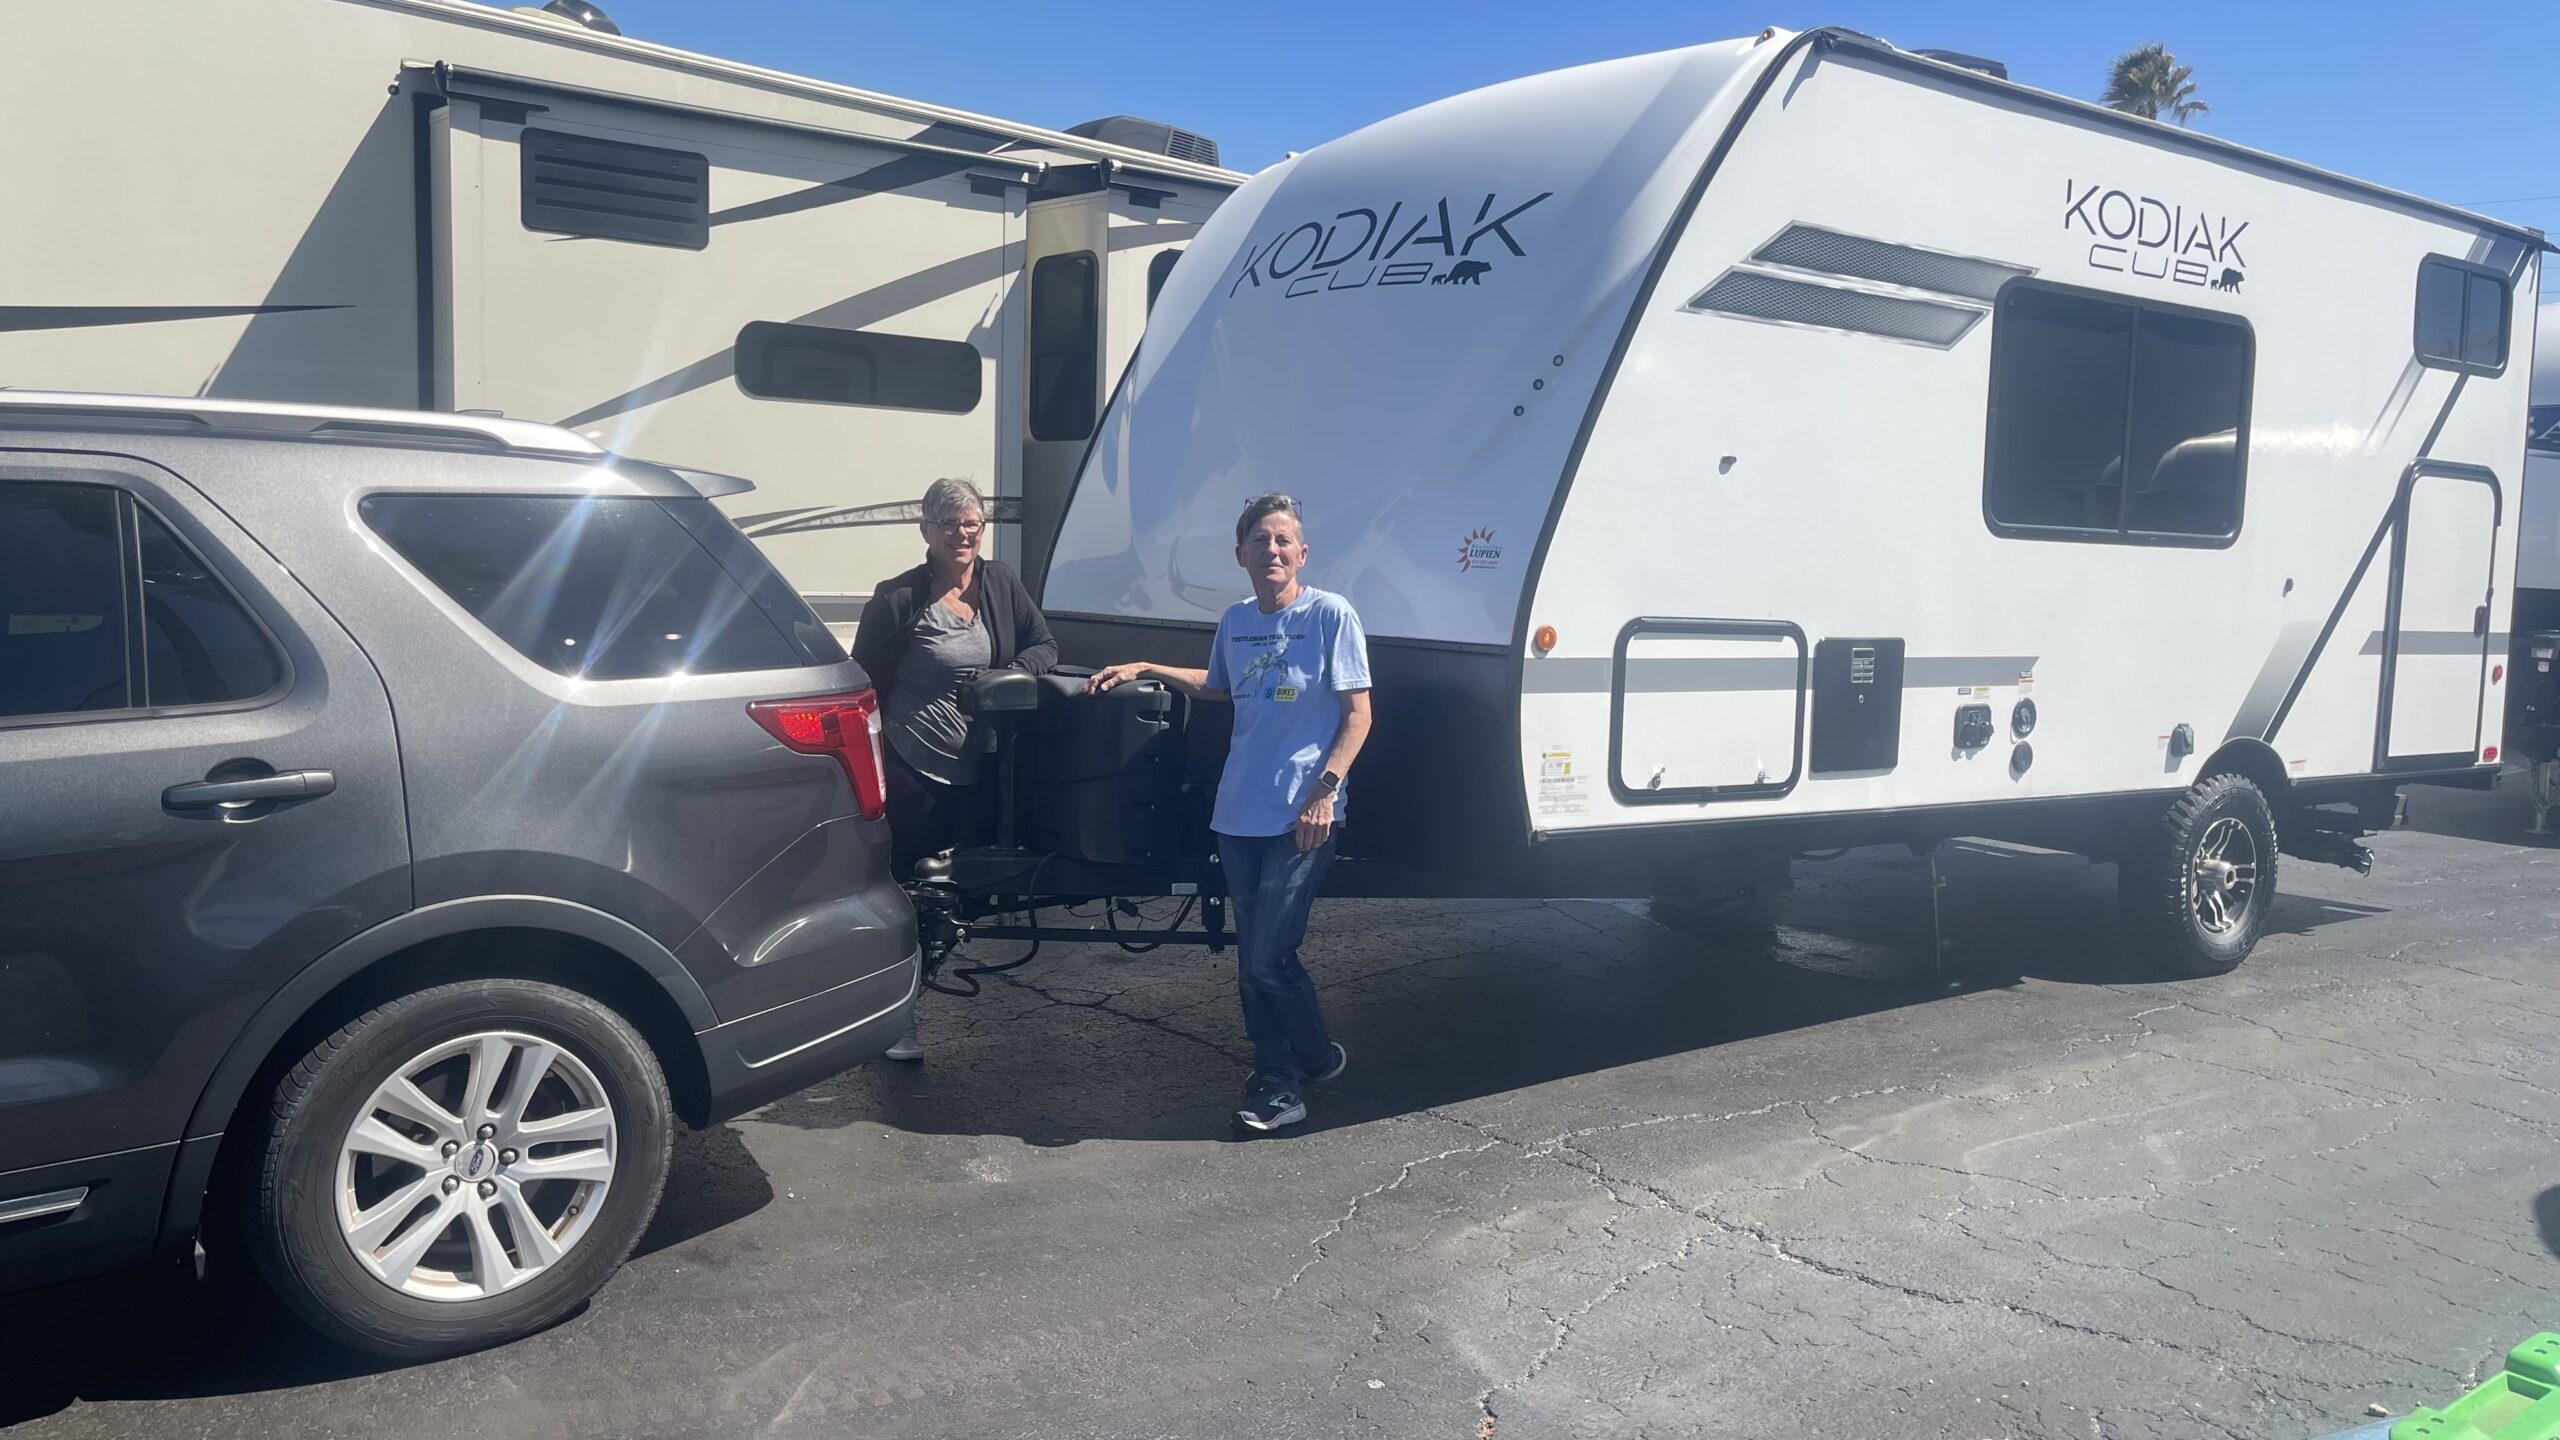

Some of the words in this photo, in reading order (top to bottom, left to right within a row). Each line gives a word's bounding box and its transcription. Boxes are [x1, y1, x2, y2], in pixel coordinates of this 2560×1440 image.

[1229, 191, 1554, 299] KODIAK
[2064, 178, 2249, 268] KODIAK
[1285, 262, 1433, 299] CUB
[2088, 243, 2209, 287] CUB
[1469, 548, 1501, 559] LUPIEN
